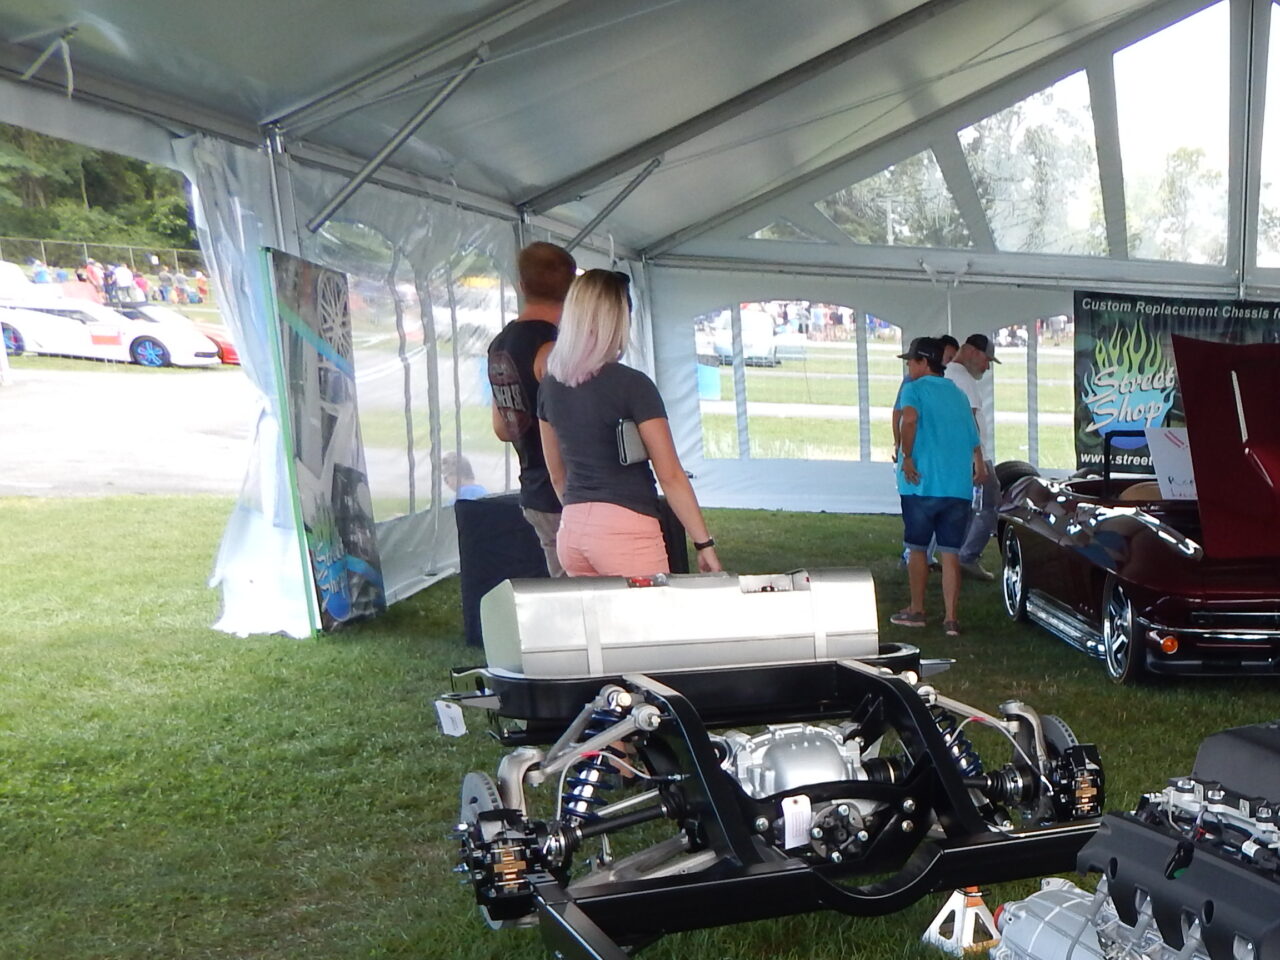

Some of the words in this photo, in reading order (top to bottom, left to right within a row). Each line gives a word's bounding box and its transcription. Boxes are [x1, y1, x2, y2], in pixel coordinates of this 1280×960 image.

[1082, 298, 1131, 312] Custom
[1136, 301, 1218, 316] Replacement
[1222, 305, 1269, 320] Chassis
[1086, 366, 1175, 403] Street
[1085, 394, 1163, 432] Shop
